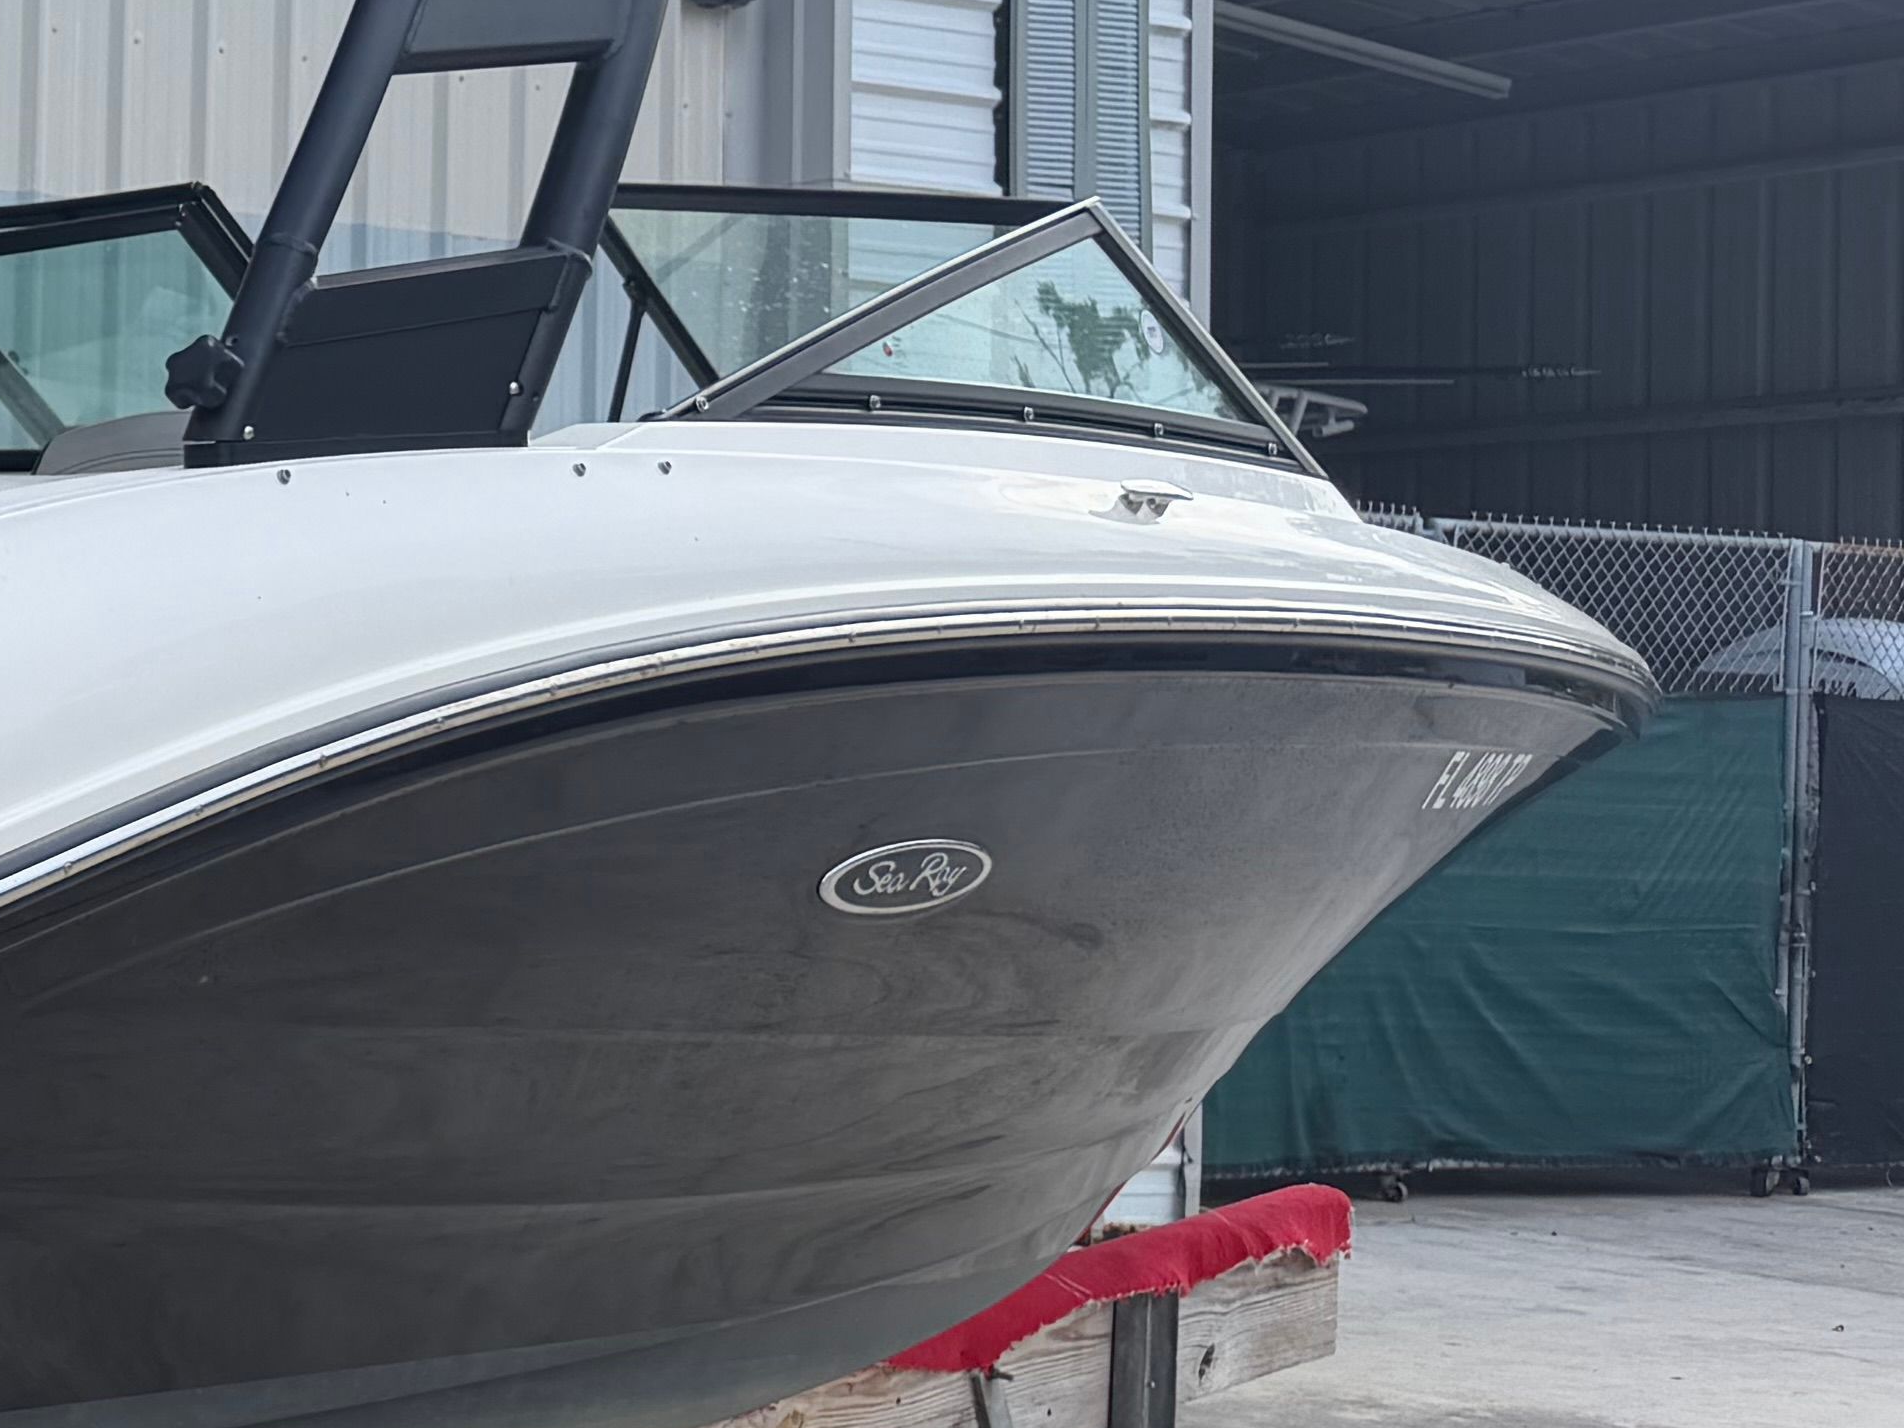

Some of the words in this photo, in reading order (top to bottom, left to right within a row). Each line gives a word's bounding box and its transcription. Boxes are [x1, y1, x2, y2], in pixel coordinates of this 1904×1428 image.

[1421, 750, 1471, 810] FL
[1481, 753, 1534, 807] TP
[852, 860, 910, 897] Sea
[909, 852, 968, 898] Ray
